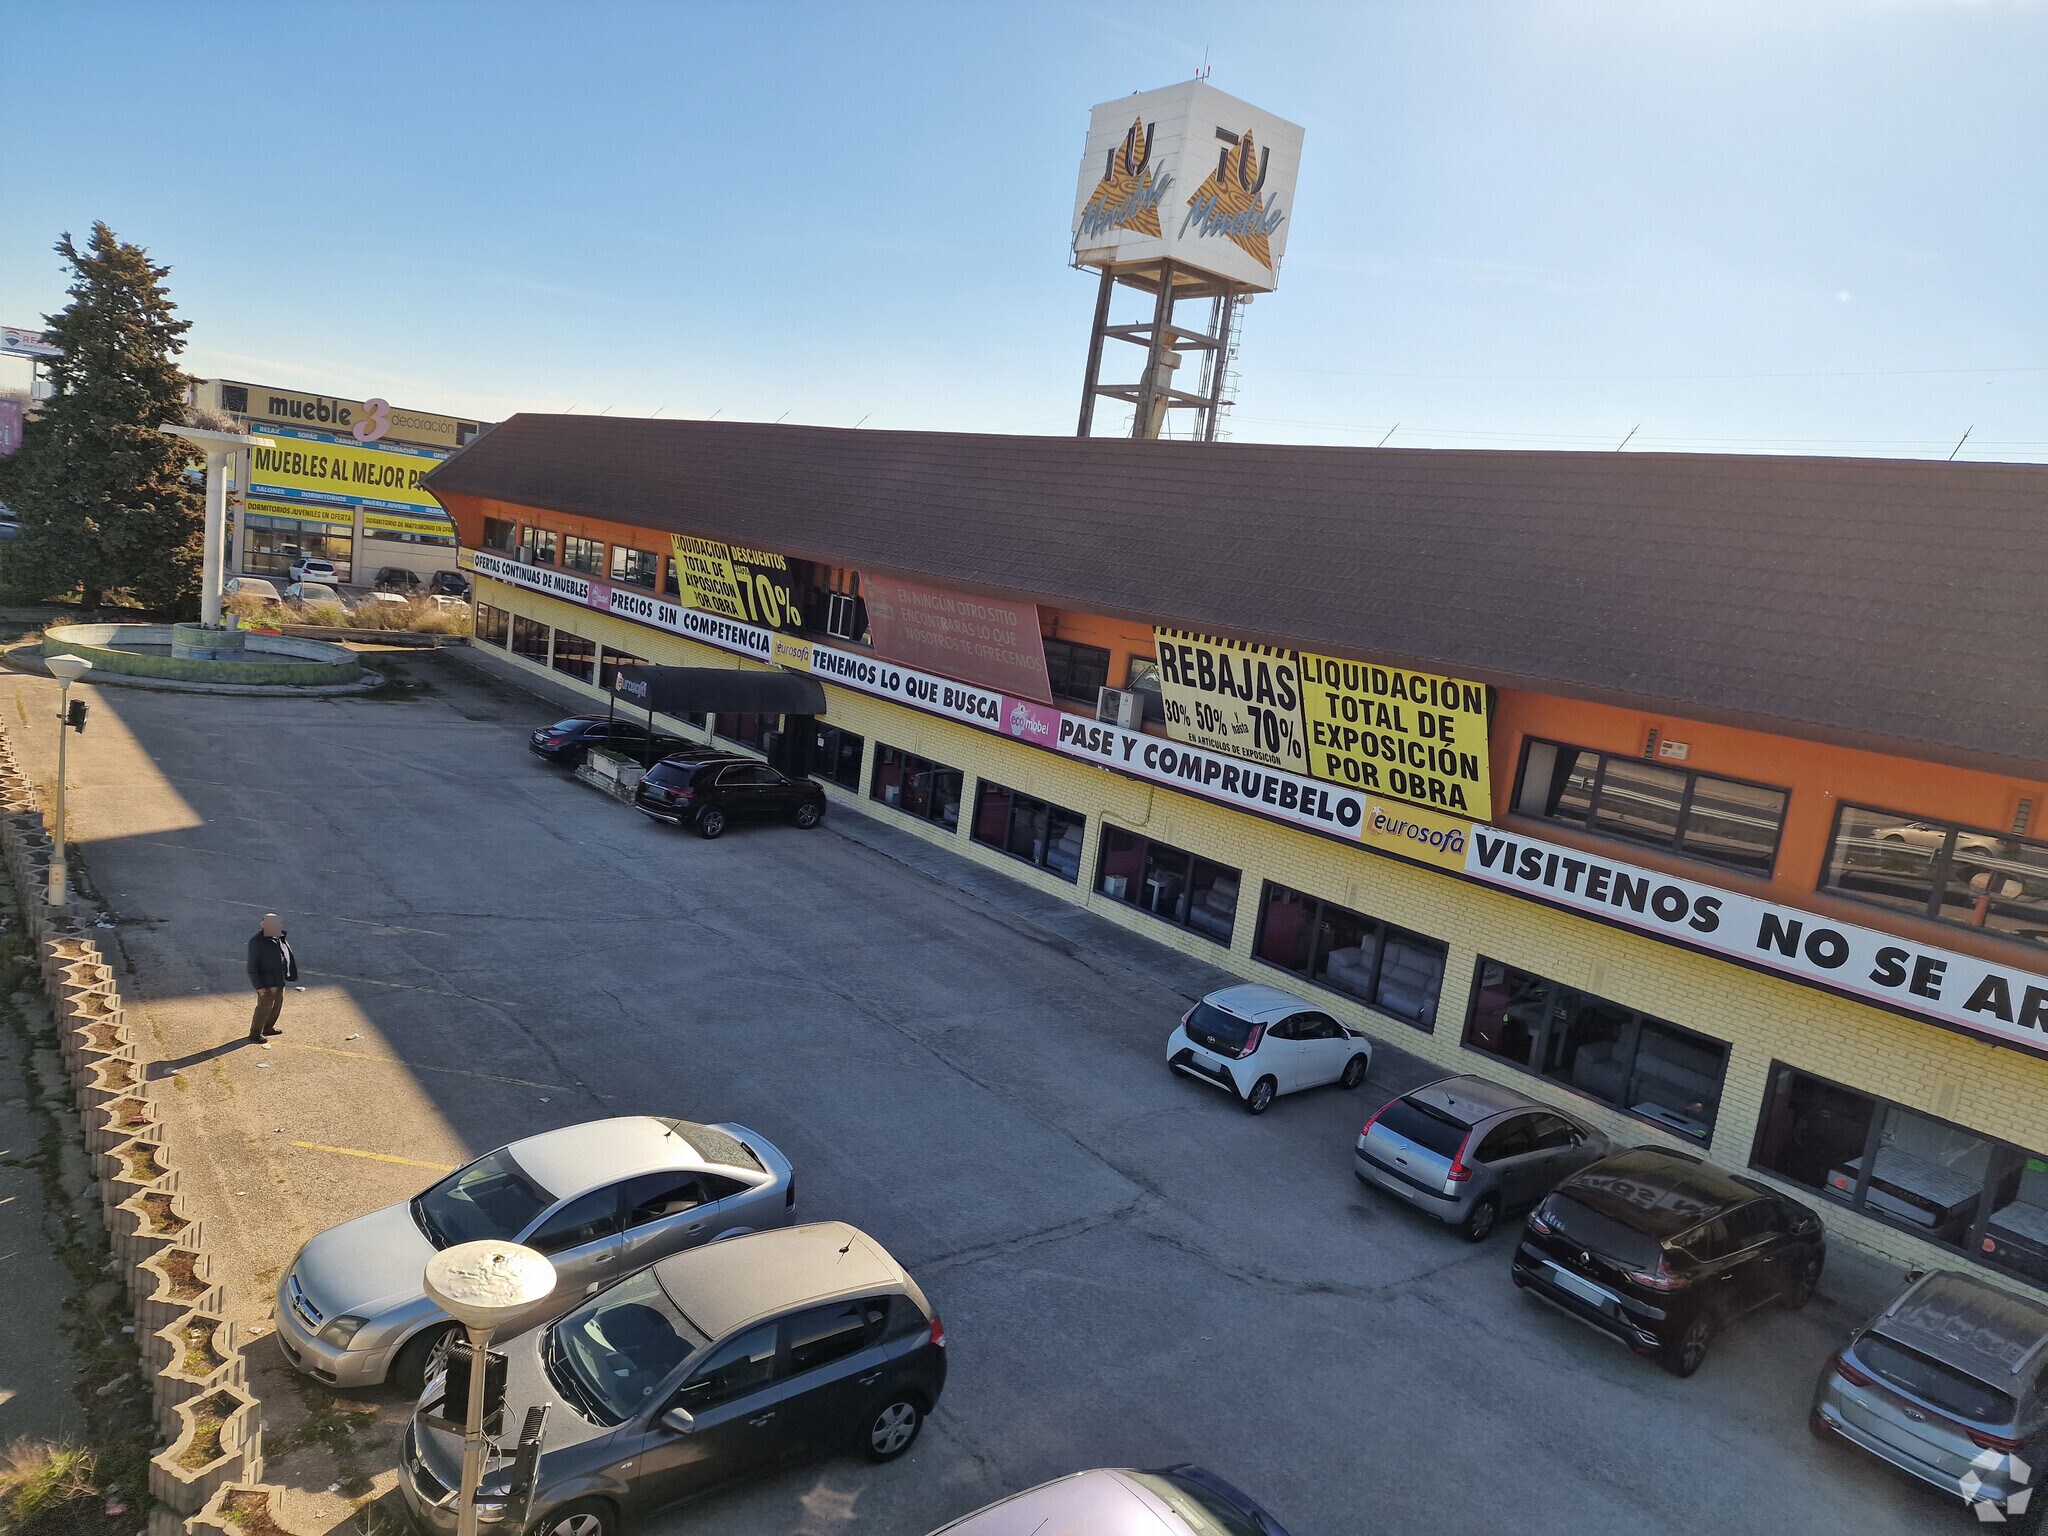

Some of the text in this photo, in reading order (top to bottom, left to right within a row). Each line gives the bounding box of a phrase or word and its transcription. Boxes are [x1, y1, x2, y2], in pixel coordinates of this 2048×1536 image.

[1215, 126, 1270, 194] TU
[259, 426, 280, 435] RELAX
[268, 396, 352, 426] mueble
[391, 413, 455, 434] decoración
[255, 447, 328, 478] MUEBLES
[330, 458, 349, 482] AL
[352, 461, 405, 489] MEJOR
[247, 502, 291, 515] DORMITORIOS
[291, 508, 321, 518] JUVENILES
[330, 512, 352, 522] OFERTA
[256, 486, 285, 495] SALONES
[300, 491, 347, 502] DORMITORIOS
[361, 499, 386, 508] MUEBLE
[387, 502, 411, 510] JUVENIL
[365, 517, 397, 527] DORMITORIO
[397, 520, 404, 528] DE
[404, 521, 435, 531] MATRIMONIO
[475, 554, 500, 573] OFERTAS
[501, 562, 541, 585] CONTINUAS
[542, 573, 552, 588] DE
[554, 576, 588, 599] MUEBLES
[683, 554, 725, 577] TOTAL DE
[729, 545, 787, 571] DESCUENTOS
[611, 592, 653, 618] PRECIOS
[658, 606, 677, 626] SIN
[684, 612, 771, 654] COMPETENCIA
[711, 595, 739, 616] OBRA
[737, 573, 801, 628] 70%
[897, 588, 912, 602] EN
[957, 602, 987, 620] OTRO
[988, 607, 1017, 627] SITIO
[905, 626, 959, 651] NOSOTROS
[959, 638, 973, 655] TE
[975, 644, 1043, 673] OFRECEMOS
[977, 624, 991, 640] LO
[992, 627, 1018, 647] QUE
[813, 649, 876, 685] TENEMOS
[880, 669, 900, 692] LO
[905, 676, 939, 704] QUE
[943, 687, 999, 723] BUSCA
[1159, 641, 1298, 712] REBAJAS
[1164, 699, 1191, 727] 30%
[1195, 701, 1228, 737] 50%
[1231, 722, 1249, 735] hasta
[1247, 705, 1302, 759] 70%
[1325, 692, 1455, 744] TOTAL DE
[1188, 733, 1197, 742] EN
[1232, 746, 1241, 754] DE
[1313, 720, 1479, 782] EXPOSICIÓN
[1059, 719, 1362, 827] PASE Y COMPRUEBELO
[1327, 753, 1468, 812] POR OBRA
[1475, 833, 1724, 933] VISITENOS
[1757, 913, 1850, 969] NO
[1868, 946, 1948, 1001] SE
